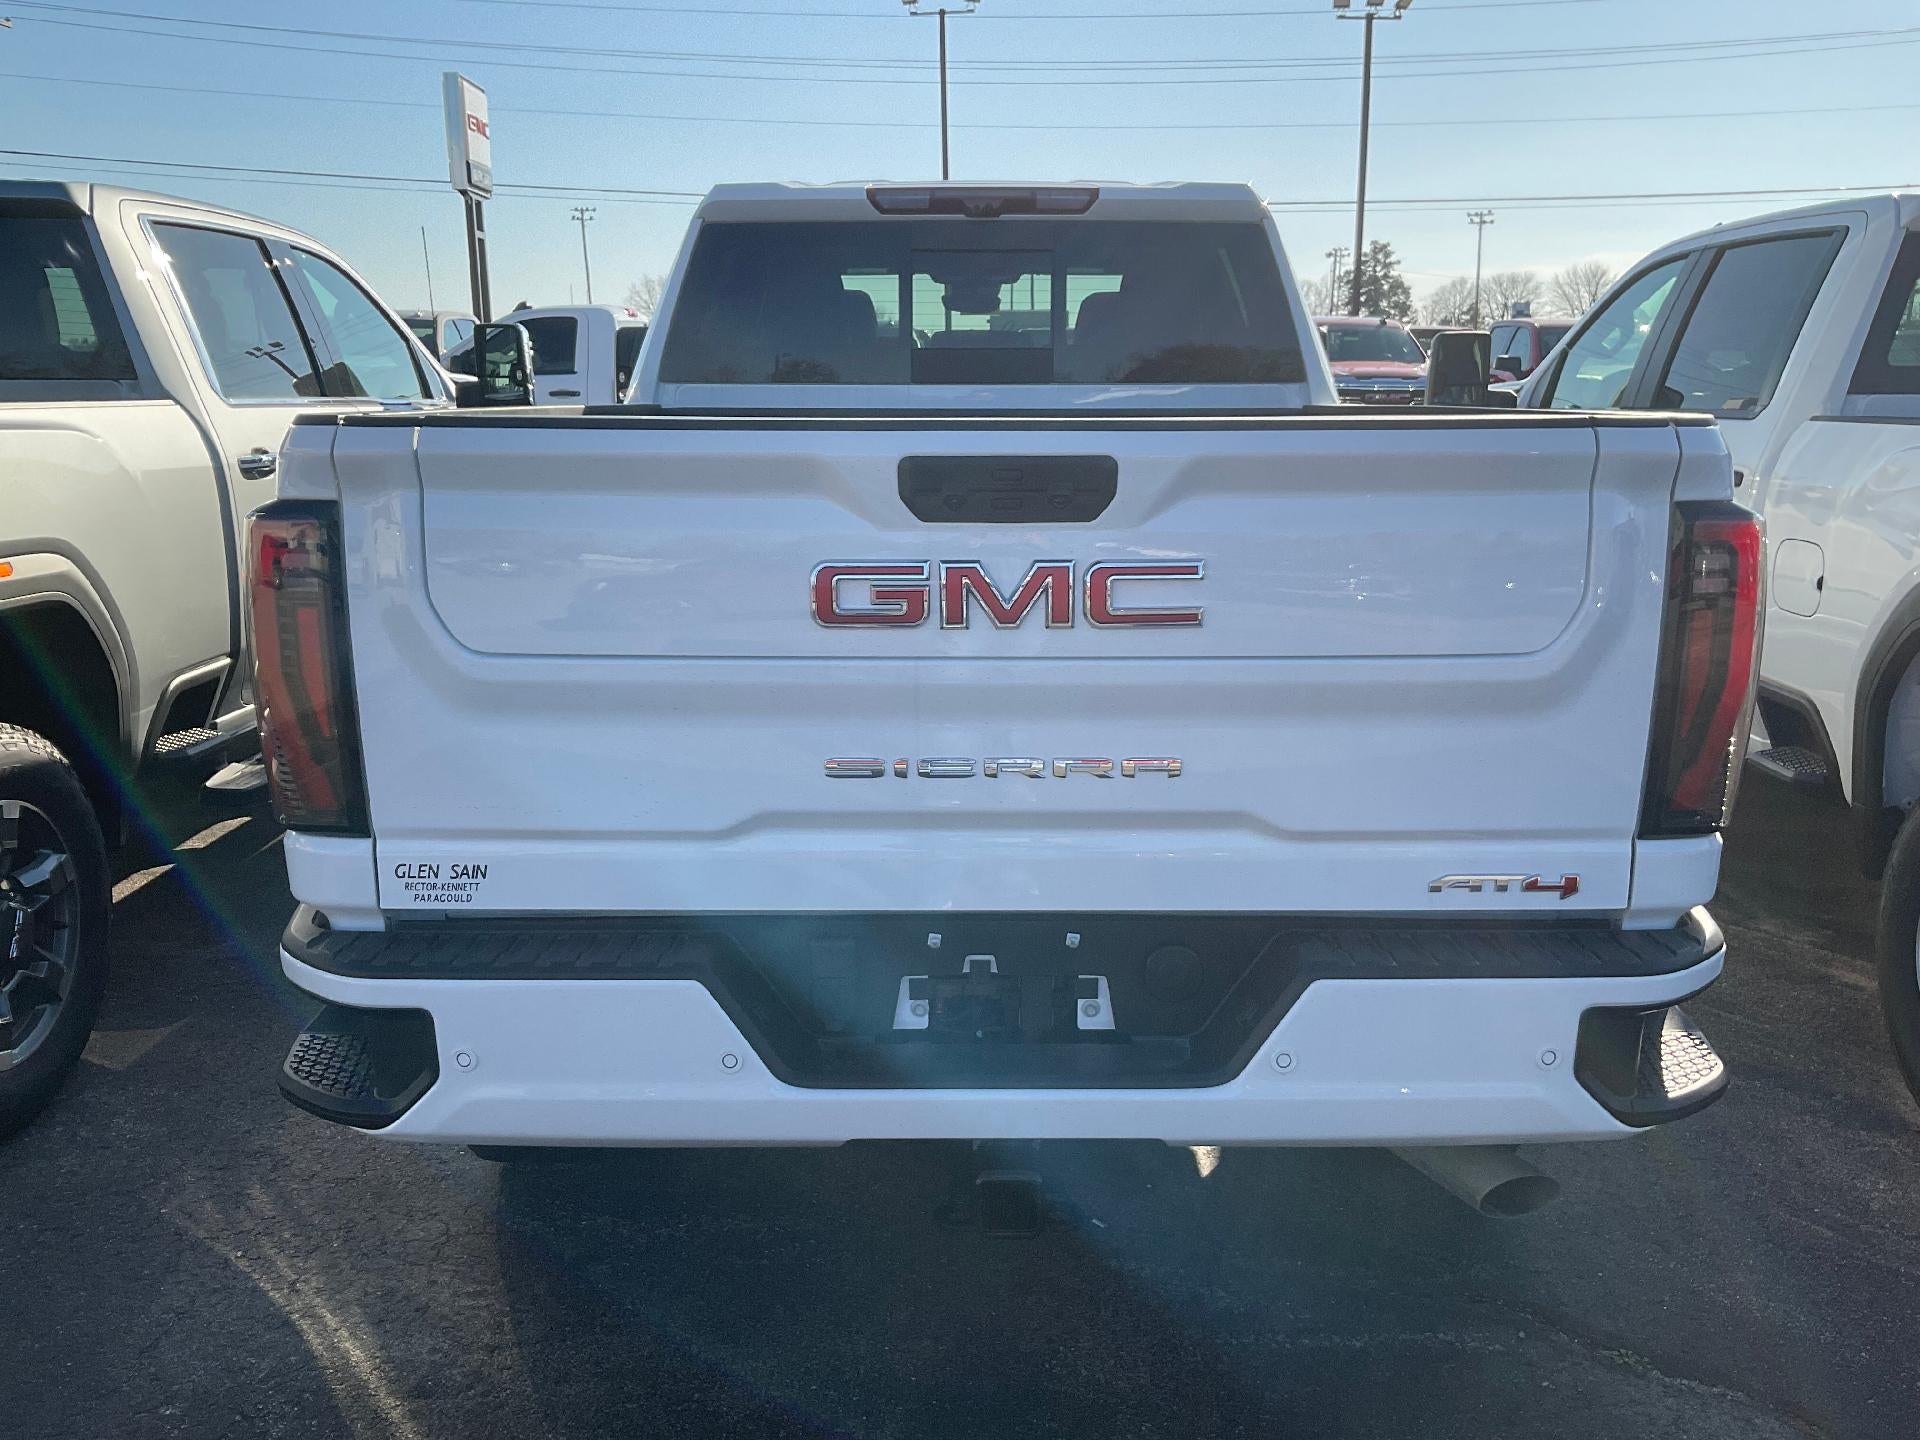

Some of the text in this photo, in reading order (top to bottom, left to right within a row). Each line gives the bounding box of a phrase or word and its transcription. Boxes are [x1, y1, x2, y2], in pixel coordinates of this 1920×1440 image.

[467, 113, 490, 140] GMC
[810, 559, 1205, 630] GMC
[824, 757, 1184, 779] SIERRA
[394, 863, 488, 880] GLEN SAIN
[404, 882, 481, 892] RECTOR-KENNETT
[1428, 873, 1580, 900] AT4
[413, 893, 473, 903] PARAGOULD
